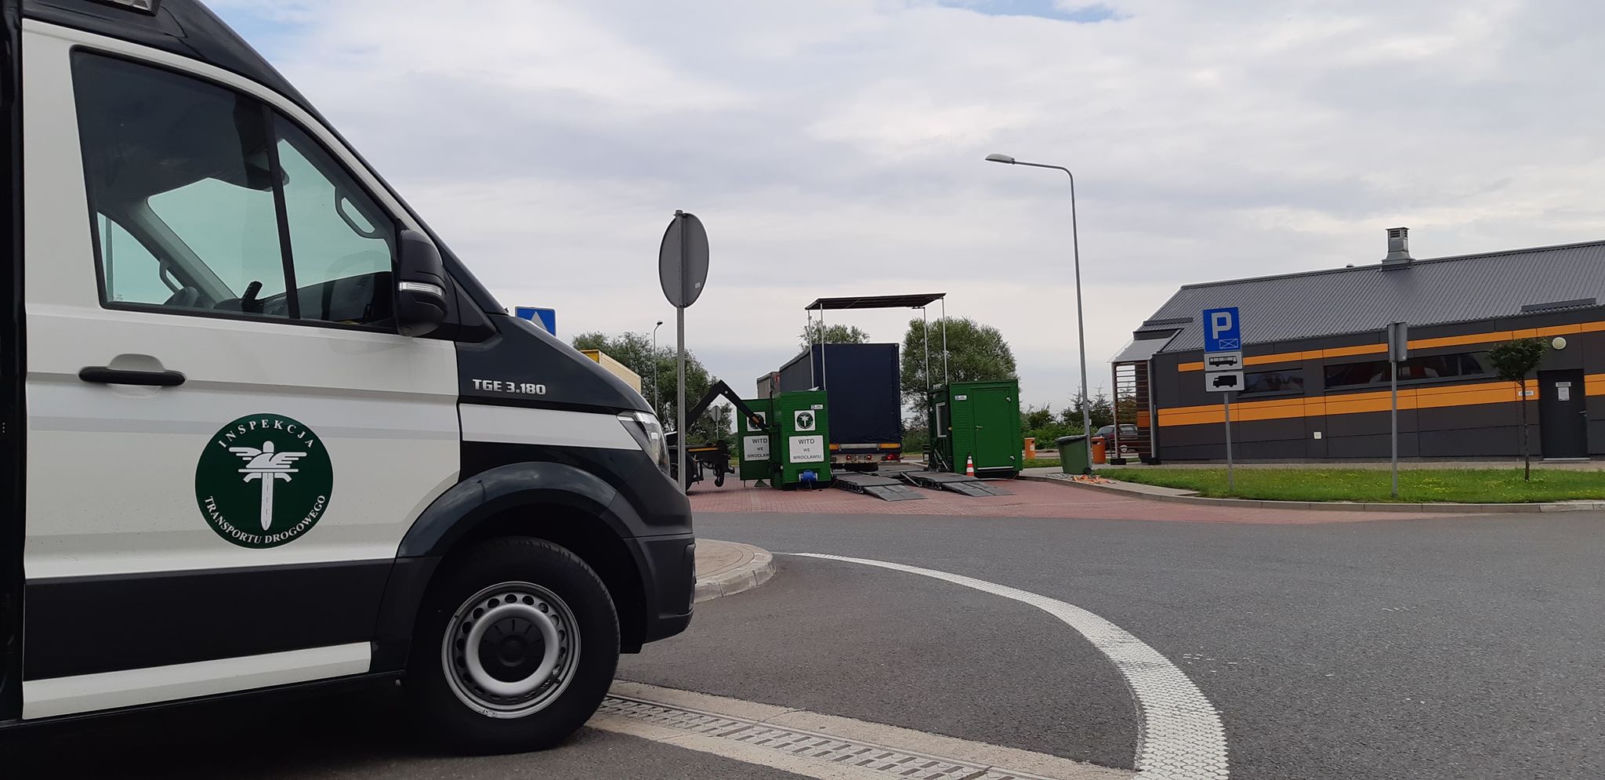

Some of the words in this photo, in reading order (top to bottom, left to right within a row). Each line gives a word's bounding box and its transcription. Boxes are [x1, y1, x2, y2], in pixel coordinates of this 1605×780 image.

[1211, 312, 1232, 339] P
[472, 379, 502, 392] TGE
[505, 381, 546, 395] 3.180
[218, 419, 314, 448] INSPEKCJA
[205, 496, 262, 544] TRANSPORTU
[264, 495, 326, 544] DROGOWEGO
